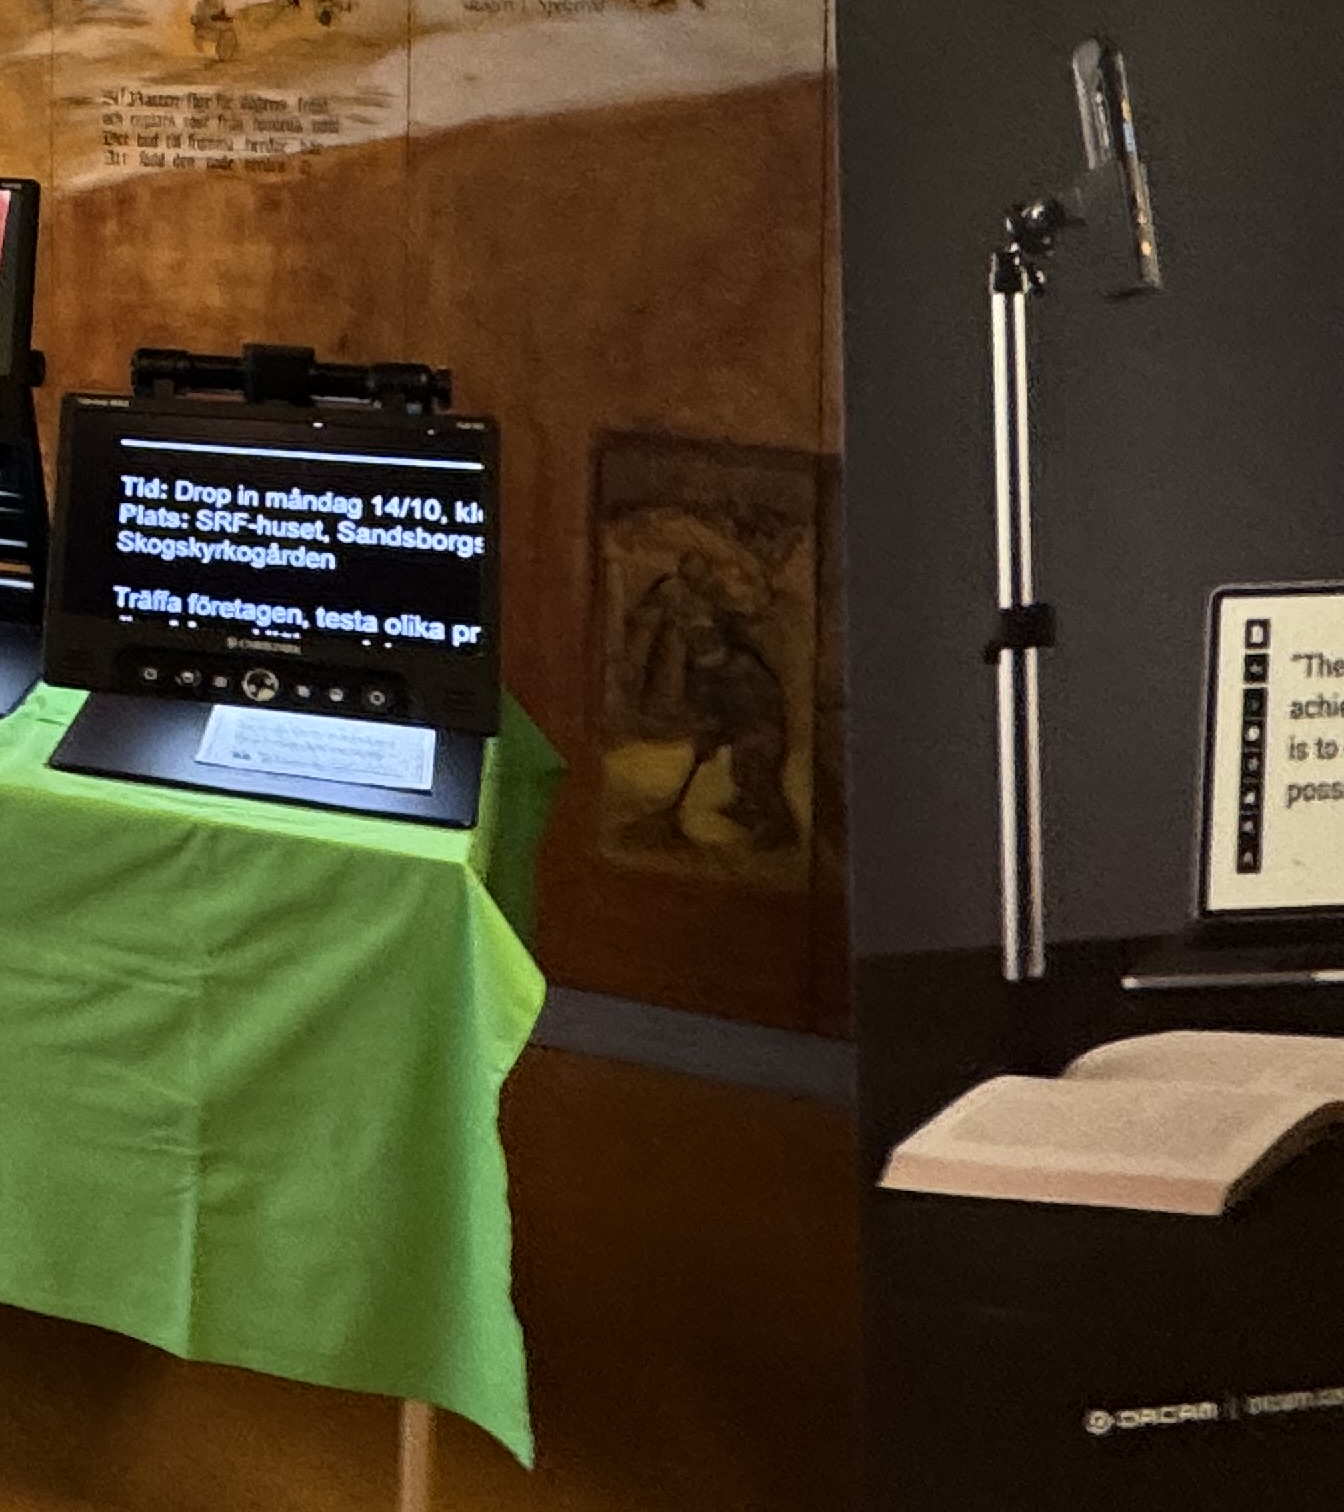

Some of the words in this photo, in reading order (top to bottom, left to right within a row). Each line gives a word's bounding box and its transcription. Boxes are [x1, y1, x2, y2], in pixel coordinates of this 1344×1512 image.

[120, 474, 169, 500] Tid:
[174, 479, 232, 508] Drop
[237, 483, 260, 508] in
[264, 486, 364, 520] måndag
[370, 494, 448, 526] 14/10,
[118, 502, 192, 530] Plats:
[194, 508, 330, 544] SRF-huset,
[116, 529, 337, 570] Skogskyrkogården
[113, 585, 183, 614] Träffa
[186, 592, 311, 630] företagen,
[315, 605, 380, 635] testa
[384, 614, 446, 641] olika
[451, 621, 483, 647] pr
[1288, 734, 1310, 762] is
[1313, 736, 1340, 762] to
